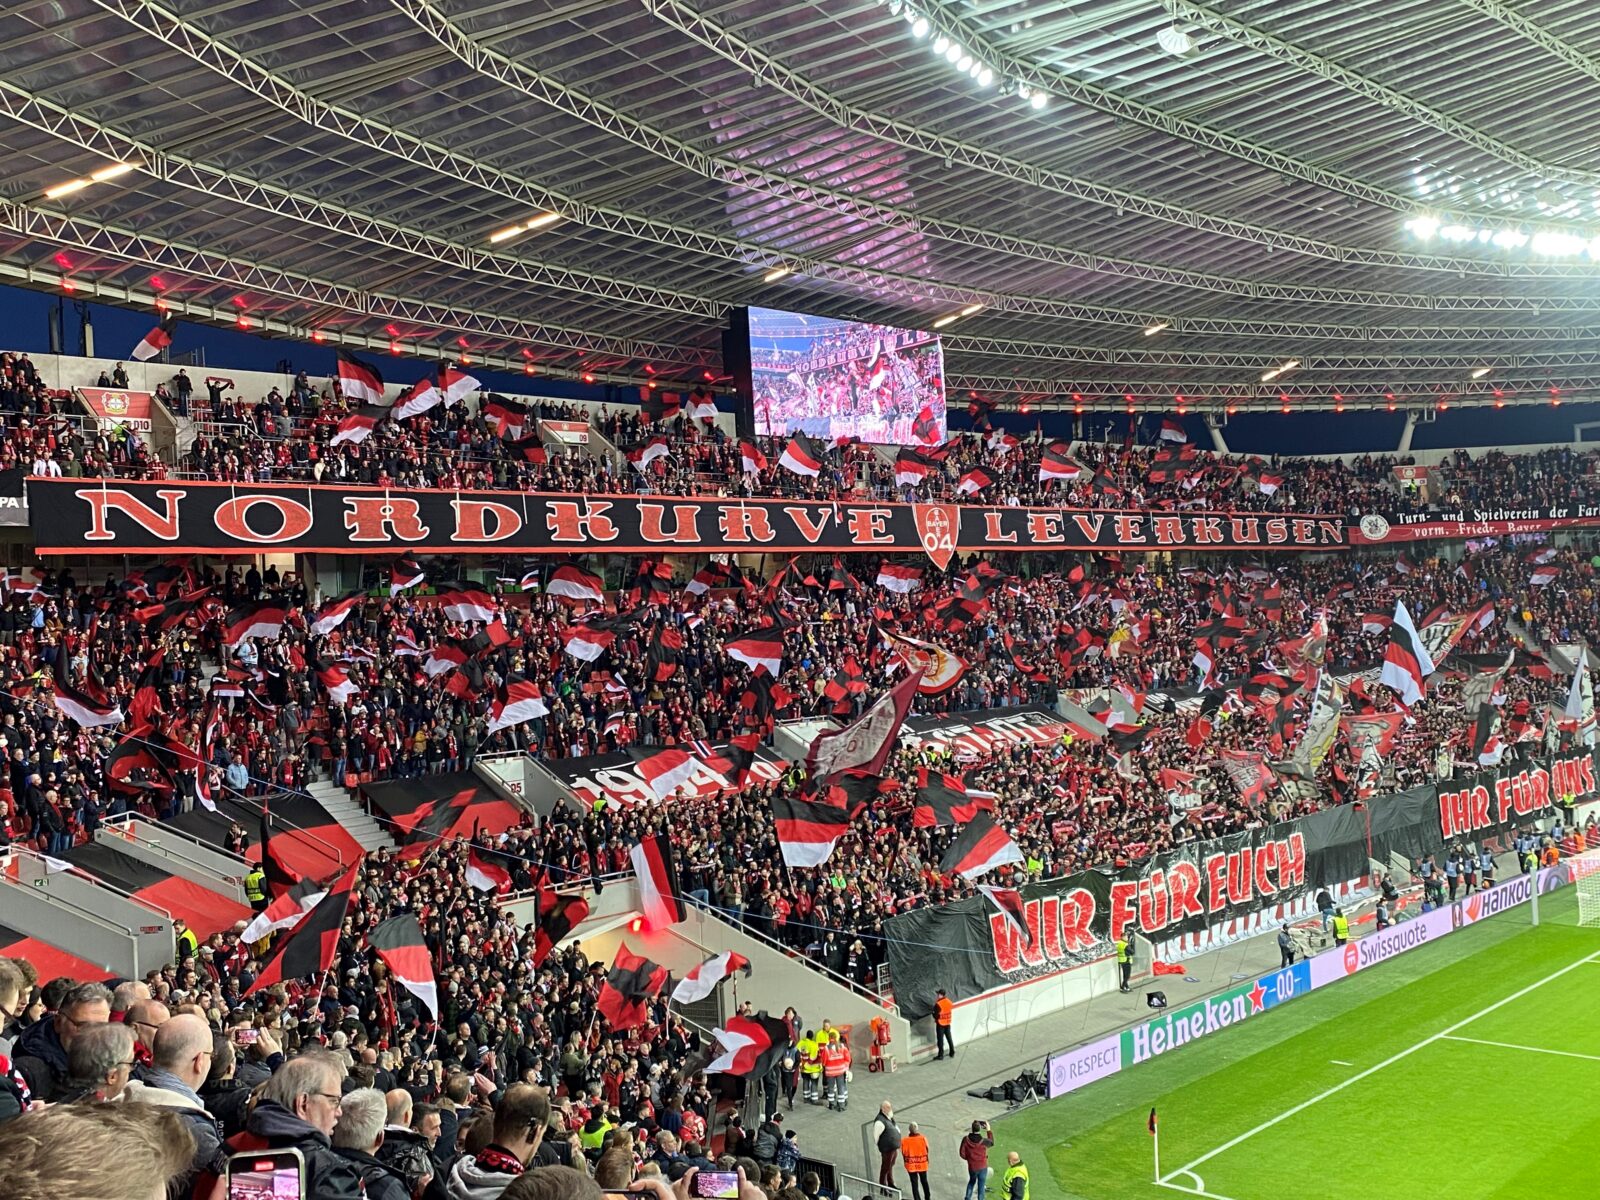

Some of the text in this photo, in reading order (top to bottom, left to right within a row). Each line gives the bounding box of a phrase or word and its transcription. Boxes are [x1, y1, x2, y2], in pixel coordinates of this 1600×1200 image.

[75, 489, 895, 544] NORDKURVE
[984, 512, 1343, 544] LEVERKUSEN
[1397, 513, 1431, 524] Turn-
[1442, 510, 1464, 522] und
[1474, 507, 1539, 524] Spielverein
[1549, 505, 1568, 518] der
[1578, 504, 1600, 517] Far
[1414, 525, 1450, 537] vorm.
[1458, 523, 1498, 535] Friedr.
[924, 532, 953, 552] 04
[1439, 753, 1596, 840] IHR FÜR UNS
[990, 888, 1101, 974] WIR
[1110, 861, 1204, 942] FÜR
[1206, 832, 1306, 914] EUCH
[1360, 922, 1427, 965] Swissquote
[1132, 994, 1248, 1064] Heineken
[1070, 1046, 1117, 1079] RESPECT
